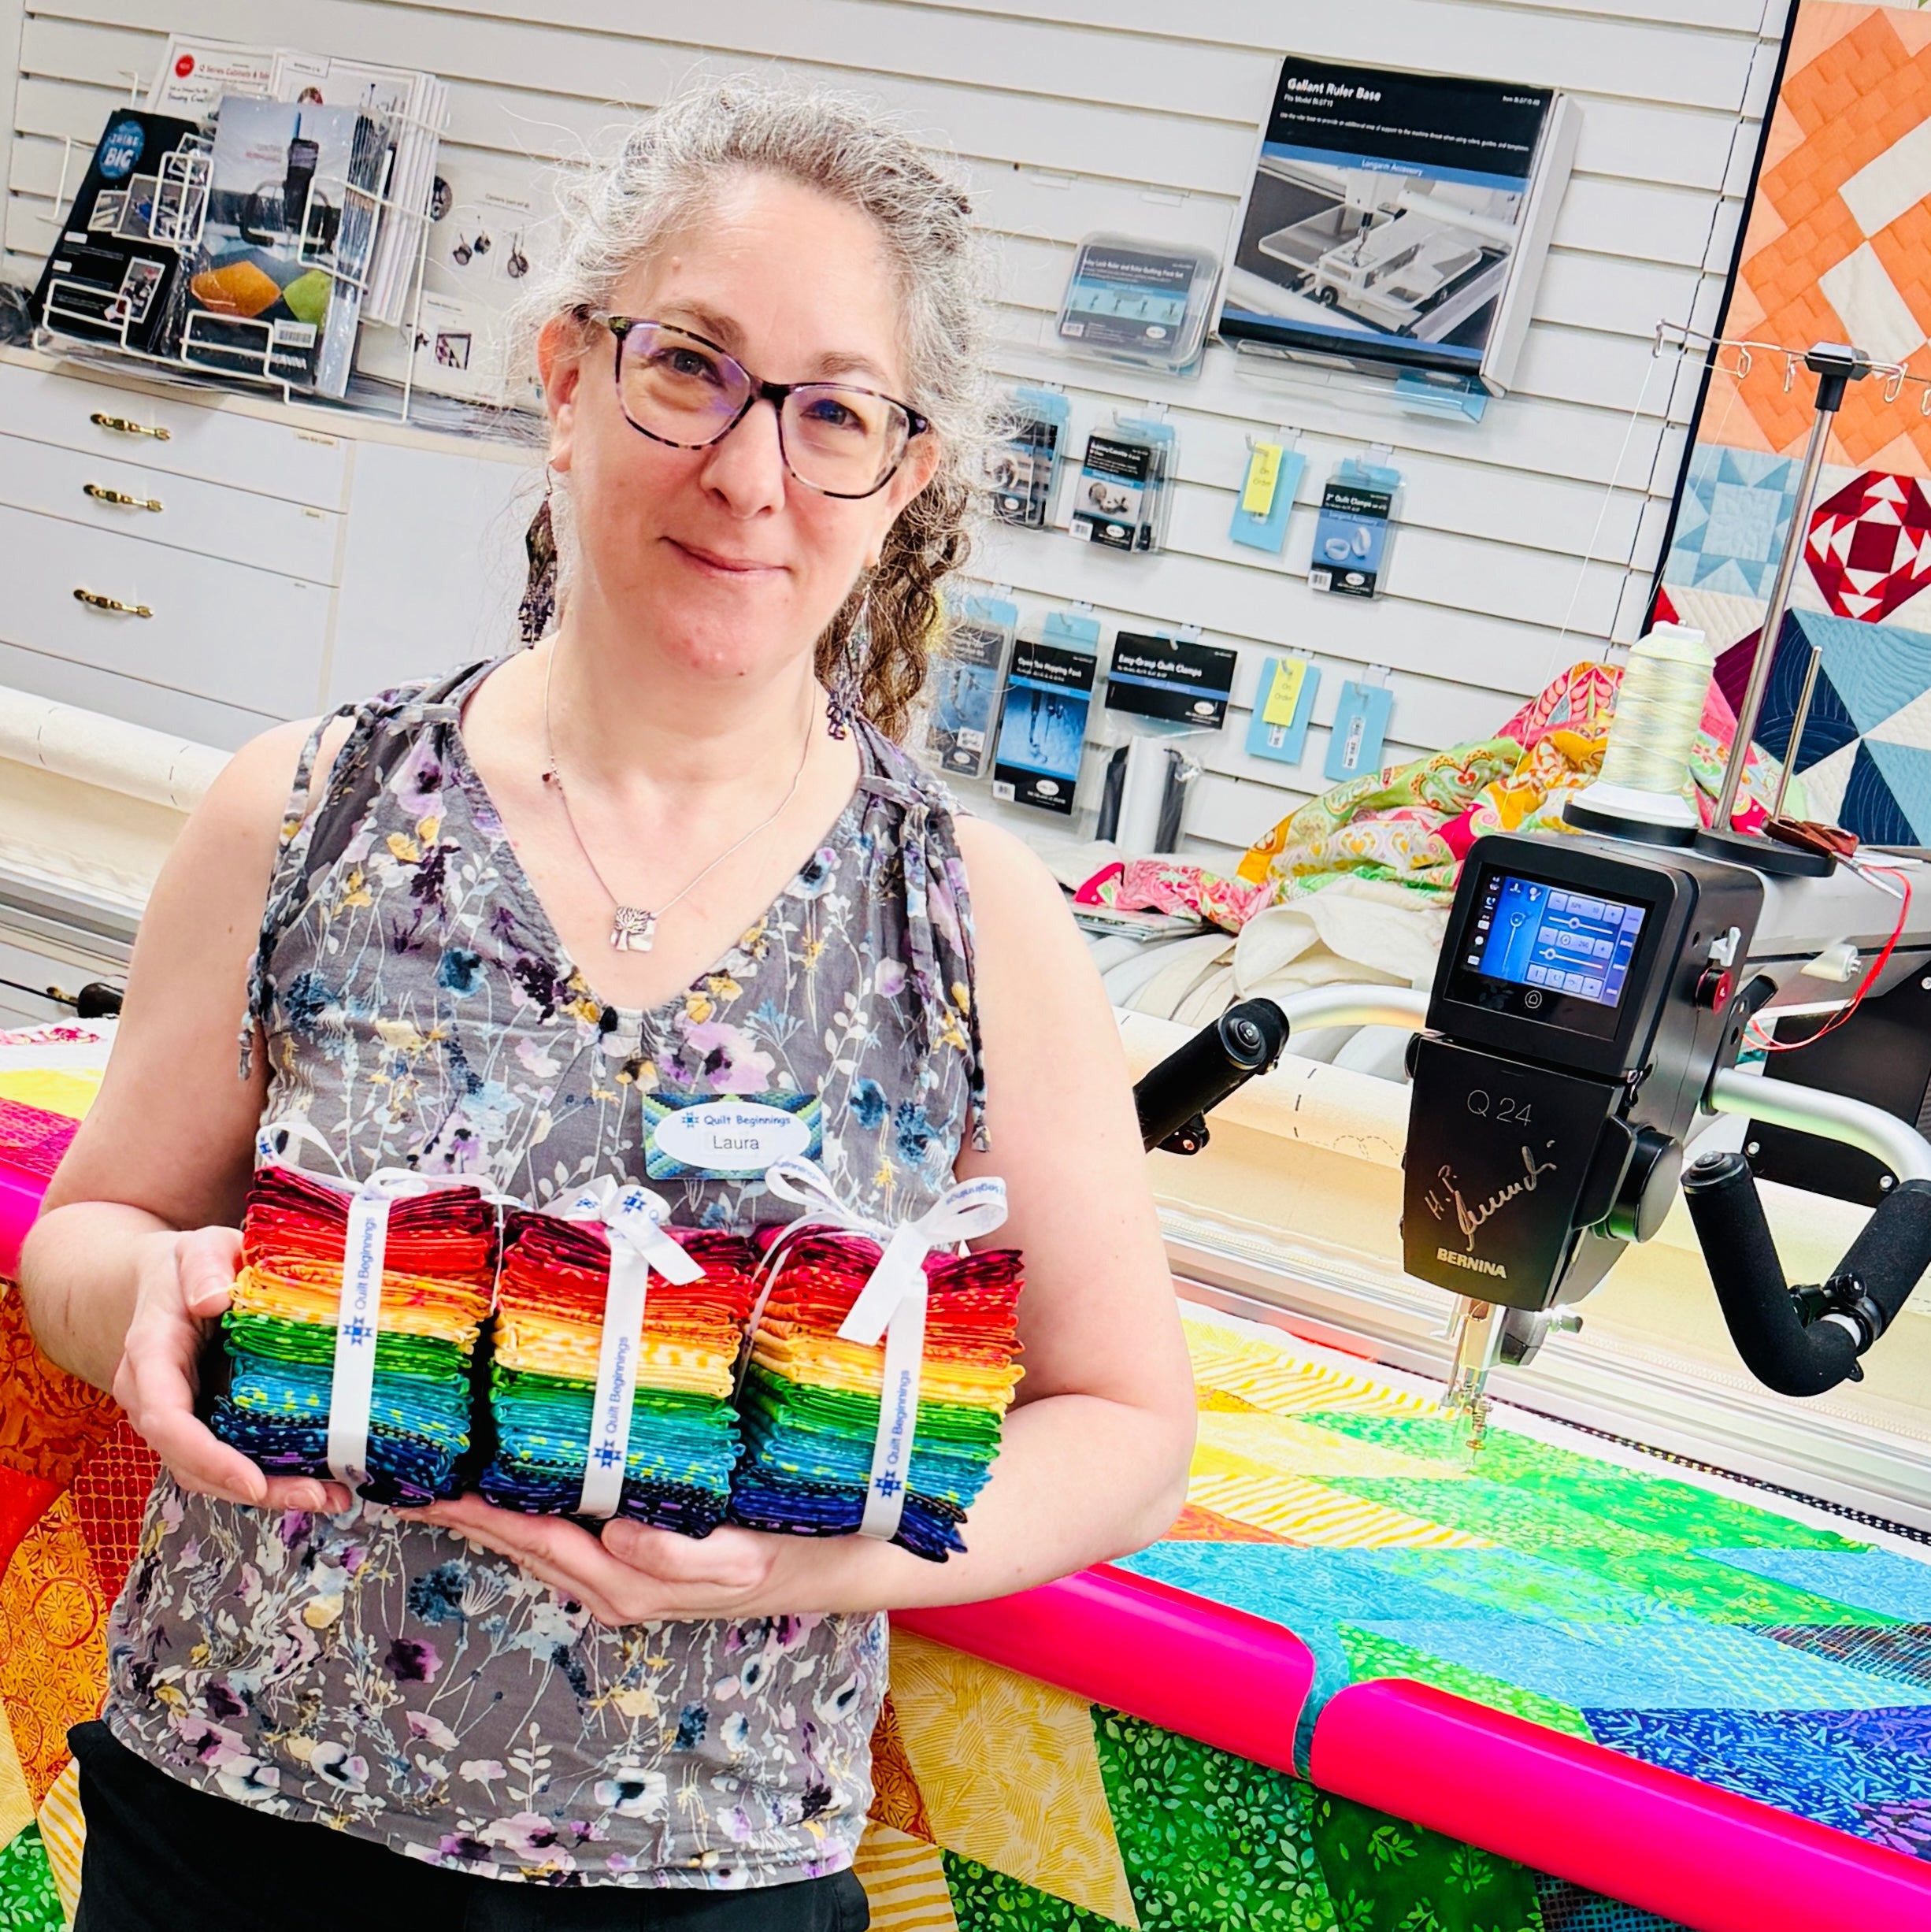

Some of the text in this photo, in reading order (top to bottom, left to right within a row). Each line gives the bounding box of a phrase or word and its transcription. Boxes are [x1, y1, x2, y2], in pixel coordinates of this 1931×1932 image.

[1287, 78, 1381, 102] Gallant Ruler Base
[104, 147, 135, 169] BIG
[1252, 477, 1272, 487] Order
[1334, 495, 1350, 503] Quilt
[1350, 497, 1372, 509] Clamps
[1157, 660, 1175, 673] Quilt
[1176, 663, 1203, 677] Clamps
[1467, 1089, 1532, 1126] Q 24
[703, 1114, 791, 1128] Quilt Beginnings
[713, 1135, 760, 1149] Laura
[354, 1216, 377, 1311] Quilt Beginnings
[1436, 1247, 1507, 1279] BERNINA
[605, 1336, 630, 1434] Quilt Beginnings
[887, 1370, 912, 1465] Quilt Beginnings
